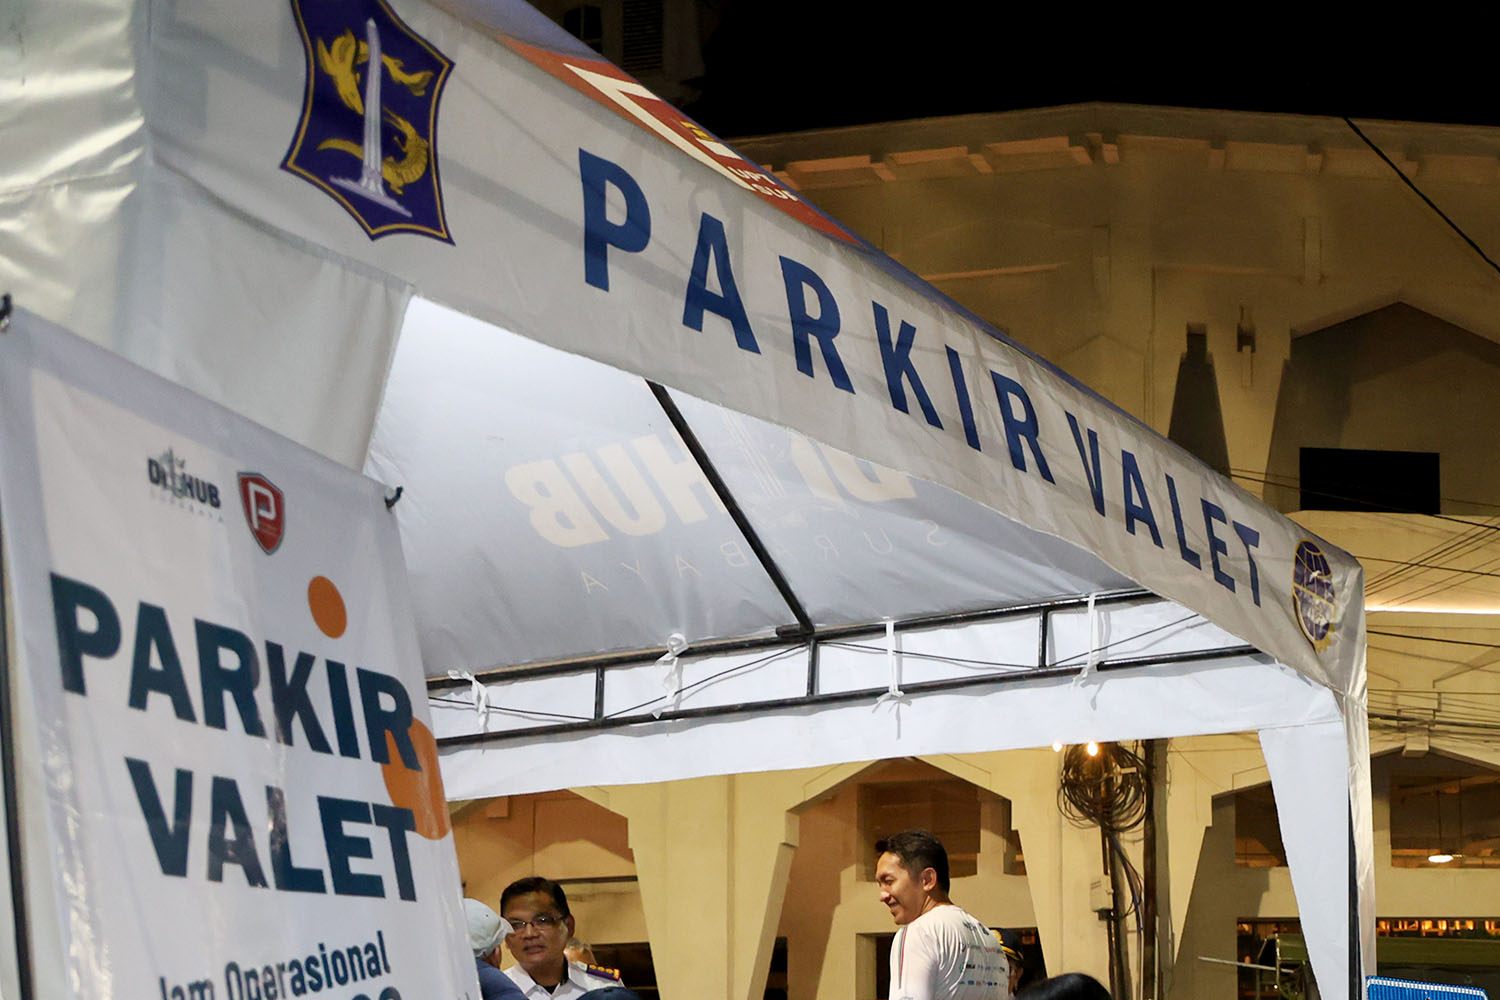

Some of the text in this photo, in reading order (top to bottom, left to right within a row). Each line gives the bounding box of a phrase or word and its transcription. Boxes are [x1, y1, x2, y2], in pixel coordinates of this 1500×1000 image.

[578, 147, 1263, 608] PARKIR VALET
[49, 571, 423, 772] PARKIR
[124, 756, 417, 902] VALET
